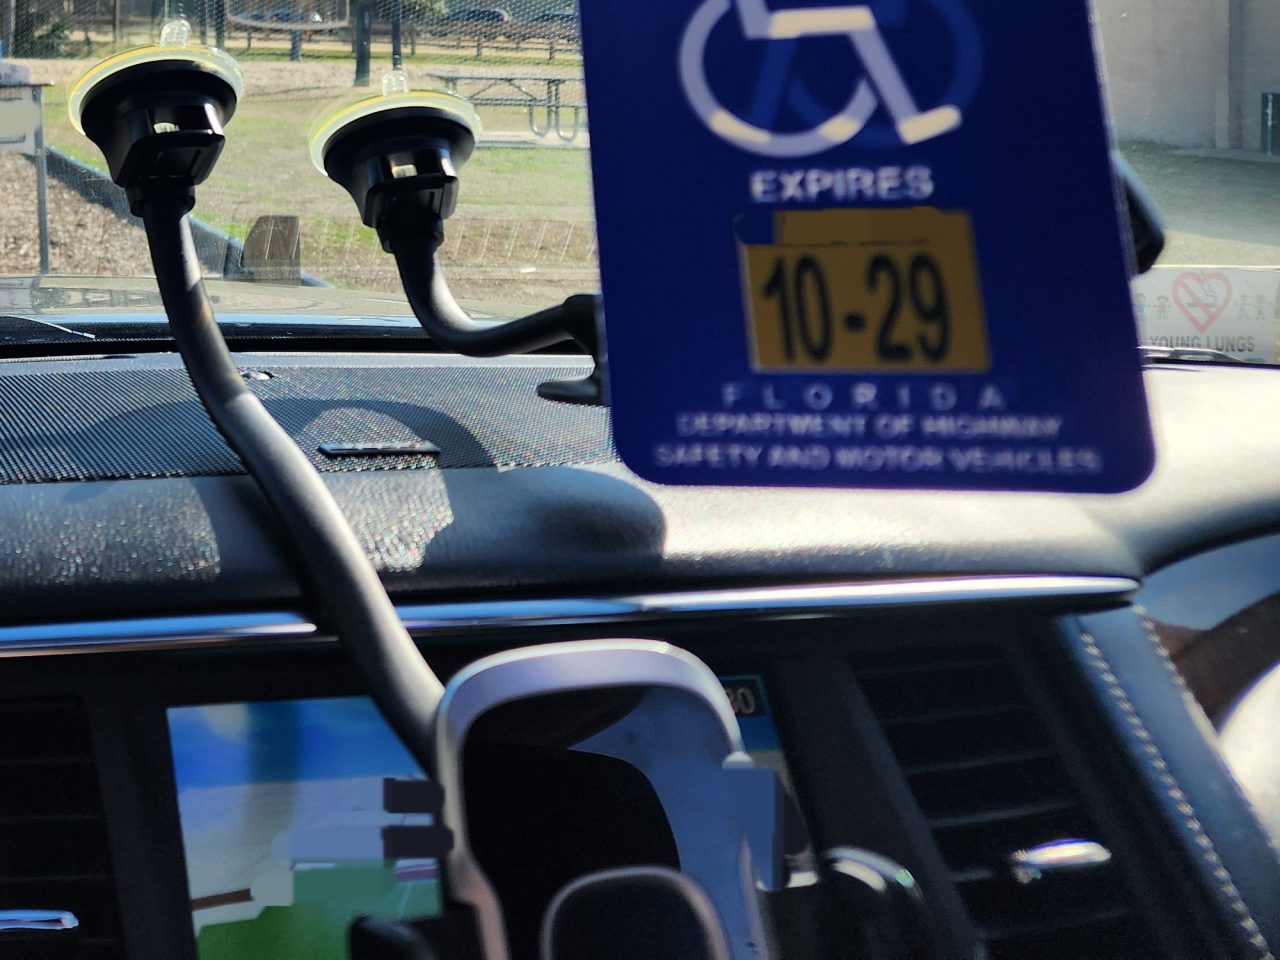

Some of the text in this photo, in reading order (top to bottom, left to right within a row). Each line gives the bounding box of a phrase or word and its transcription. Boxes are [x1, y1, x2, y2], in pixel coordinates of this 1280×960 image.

[749, 164, 935, 203] EXPIRES
[1149, 336, 1255, 352] YOUNG LUNGS
[874, 414, 915, 439] OF
[655, 444, 763, 470] SAFETY
